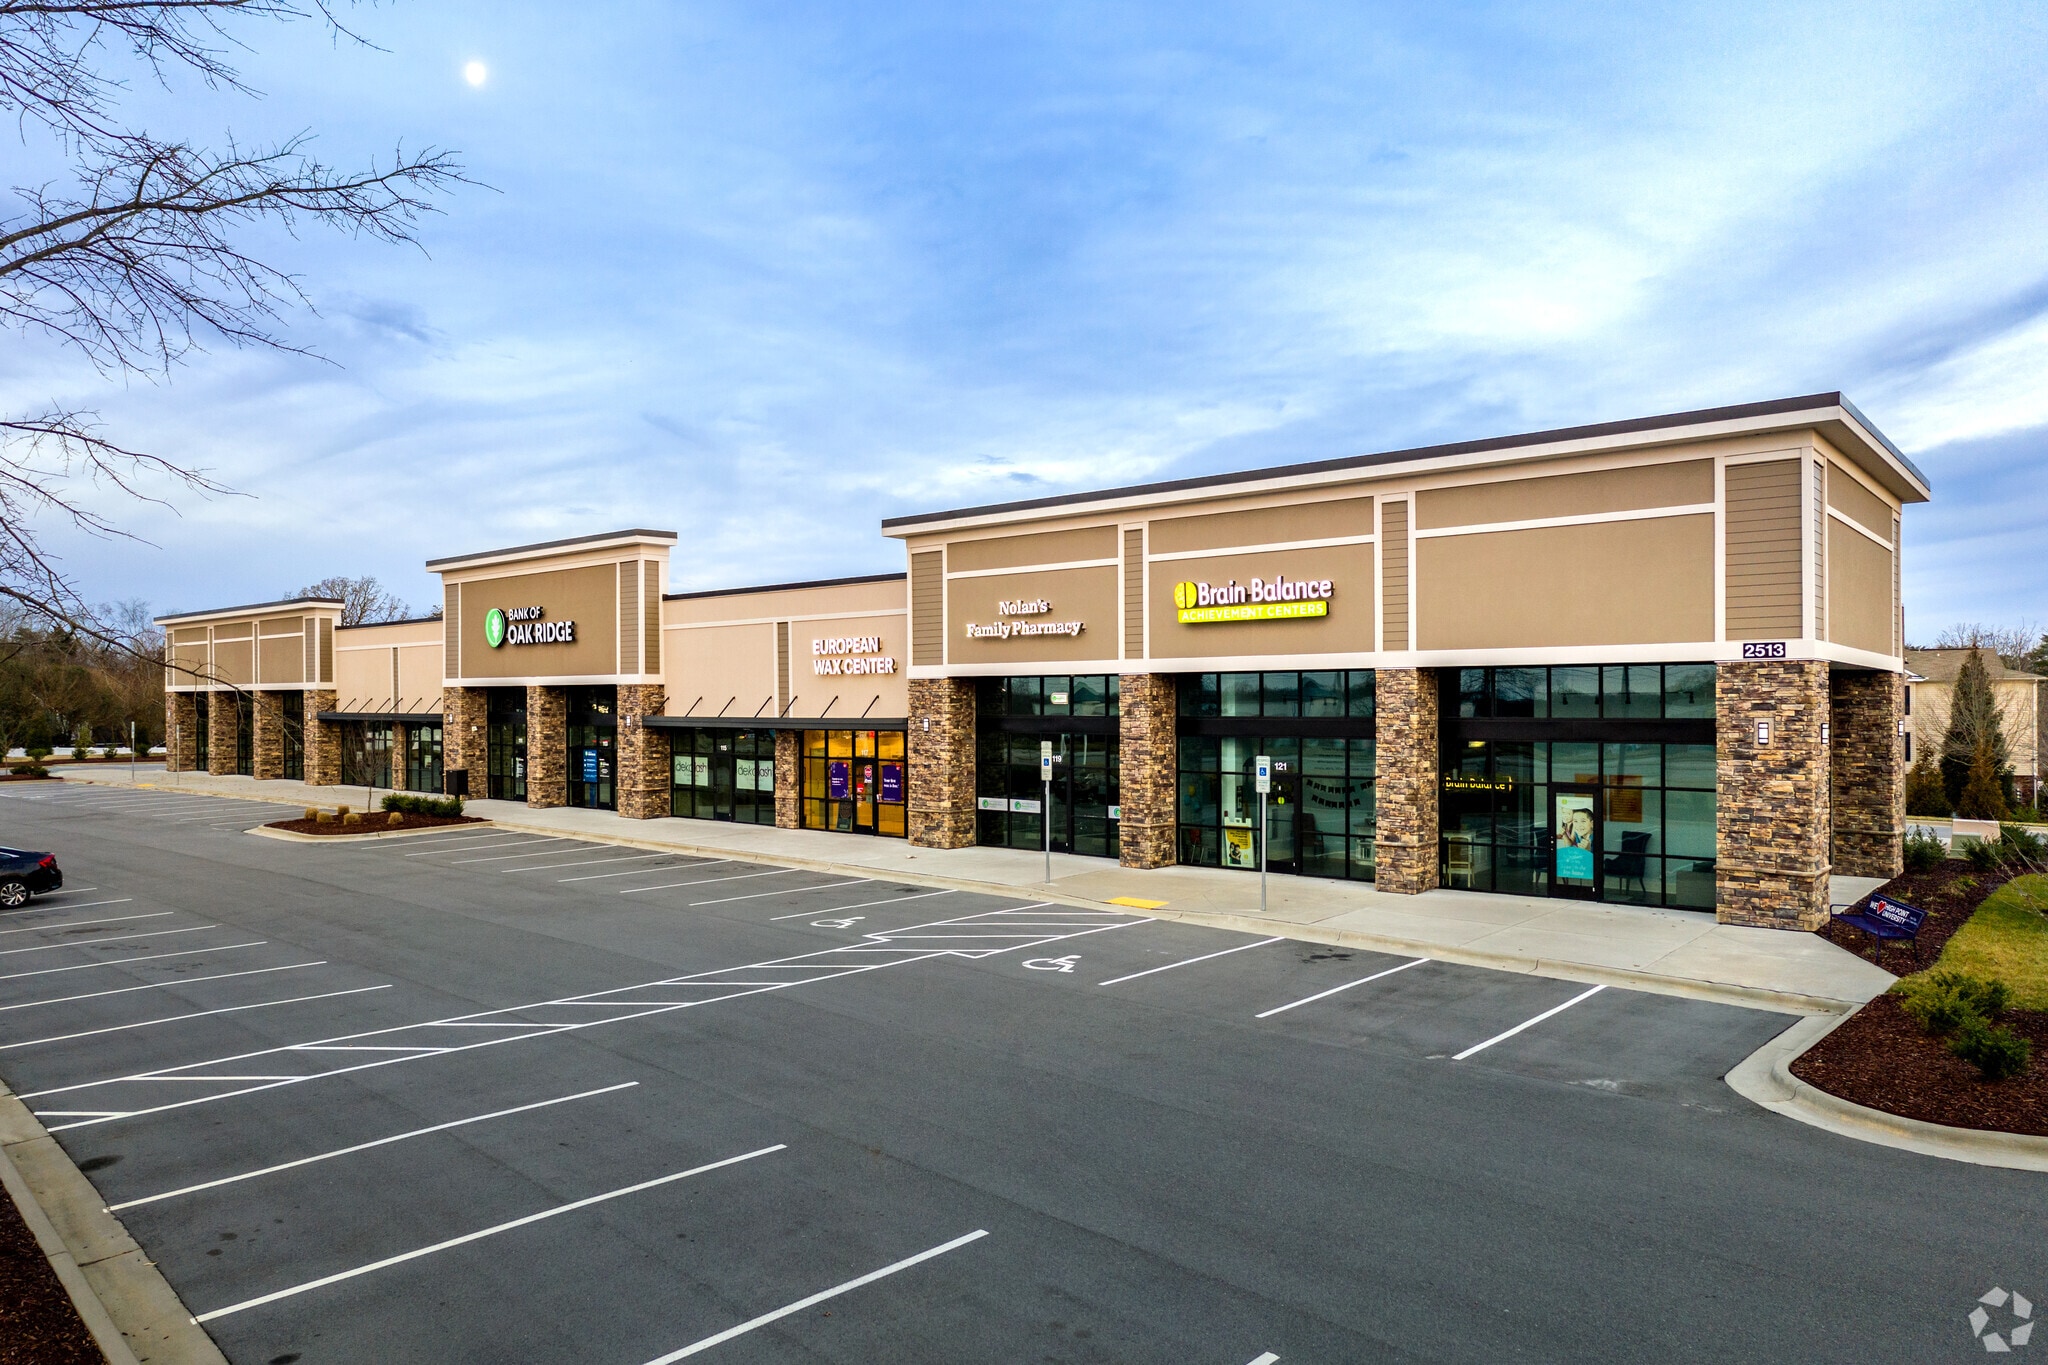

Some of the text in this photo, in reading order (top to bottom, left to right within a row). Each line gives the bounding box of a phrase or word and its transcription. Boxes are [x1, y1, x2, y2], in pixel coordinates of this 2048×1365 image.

[1198, 575, 1333, 606] Brain Balance
[508, 606, 541, 621] BANK OF
[998, 598, 1049, 616] Nolan's
[1181, 602, 1325, 621] ACHIEVEMENT CENTERS
[507, 620, 573, 645] OAK RIDGE
[965, 620, 1081, 639] Family Pharmacy
[812, 636, 879, 655] EUROPEAN
[1744, 643, 1785, 657] 2513
[813, 657, 895, 676] WAX CENTER
[1052, 755, 1062, 763] 119
[1274, 762, 1287, 771] 121
[1882, 911, 1906, 924] UNIVERSITY
[1895, 908, 1910, 918] POINT
